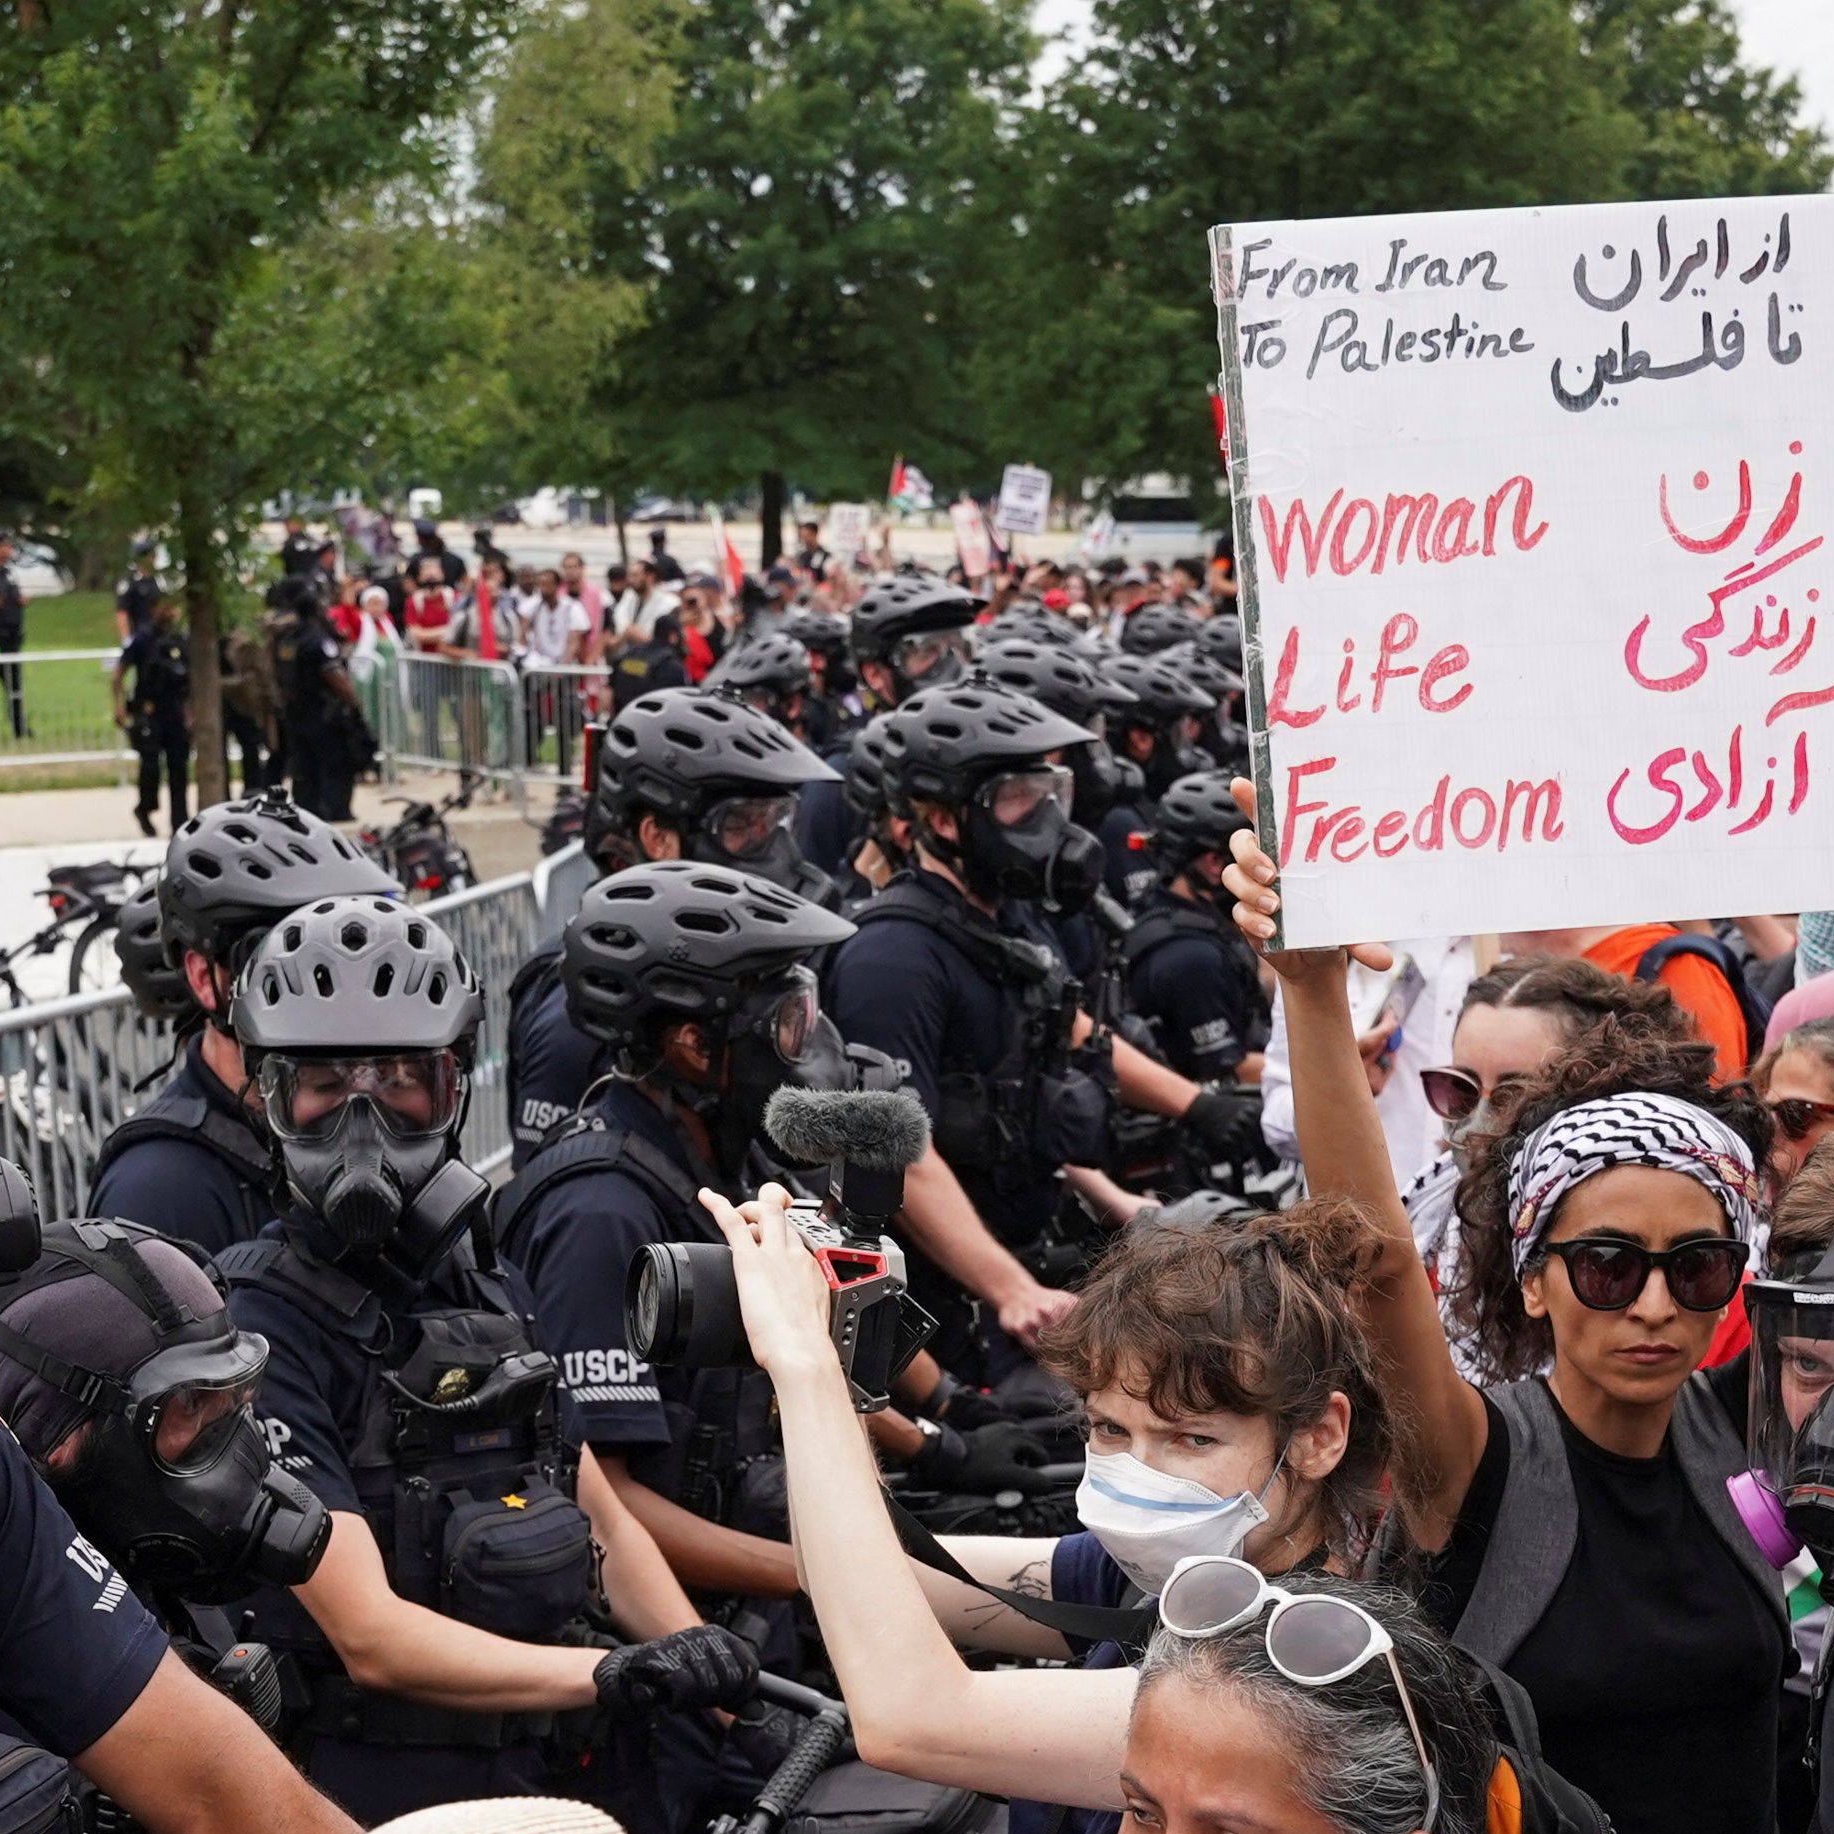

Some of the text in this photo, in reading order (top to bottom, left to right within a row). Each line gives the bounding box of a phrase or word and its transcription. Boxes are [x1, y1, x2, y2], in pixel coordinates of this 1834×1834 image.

[1236, 238, 1509, 299] From Iran
[1740, 212, 1791, 285] از
[1240, 308, 1536, 380] To Palestine
[1767, 292, 1804, 365] تا
[1658, 439, 1803, 556] زن
[1266, 613, 1474, 730] Life
[1280, 757, 1565, 870] Freedom
[521, 1098, 576, 1130] USC
[563, 1348, 650, 1386] USCP
